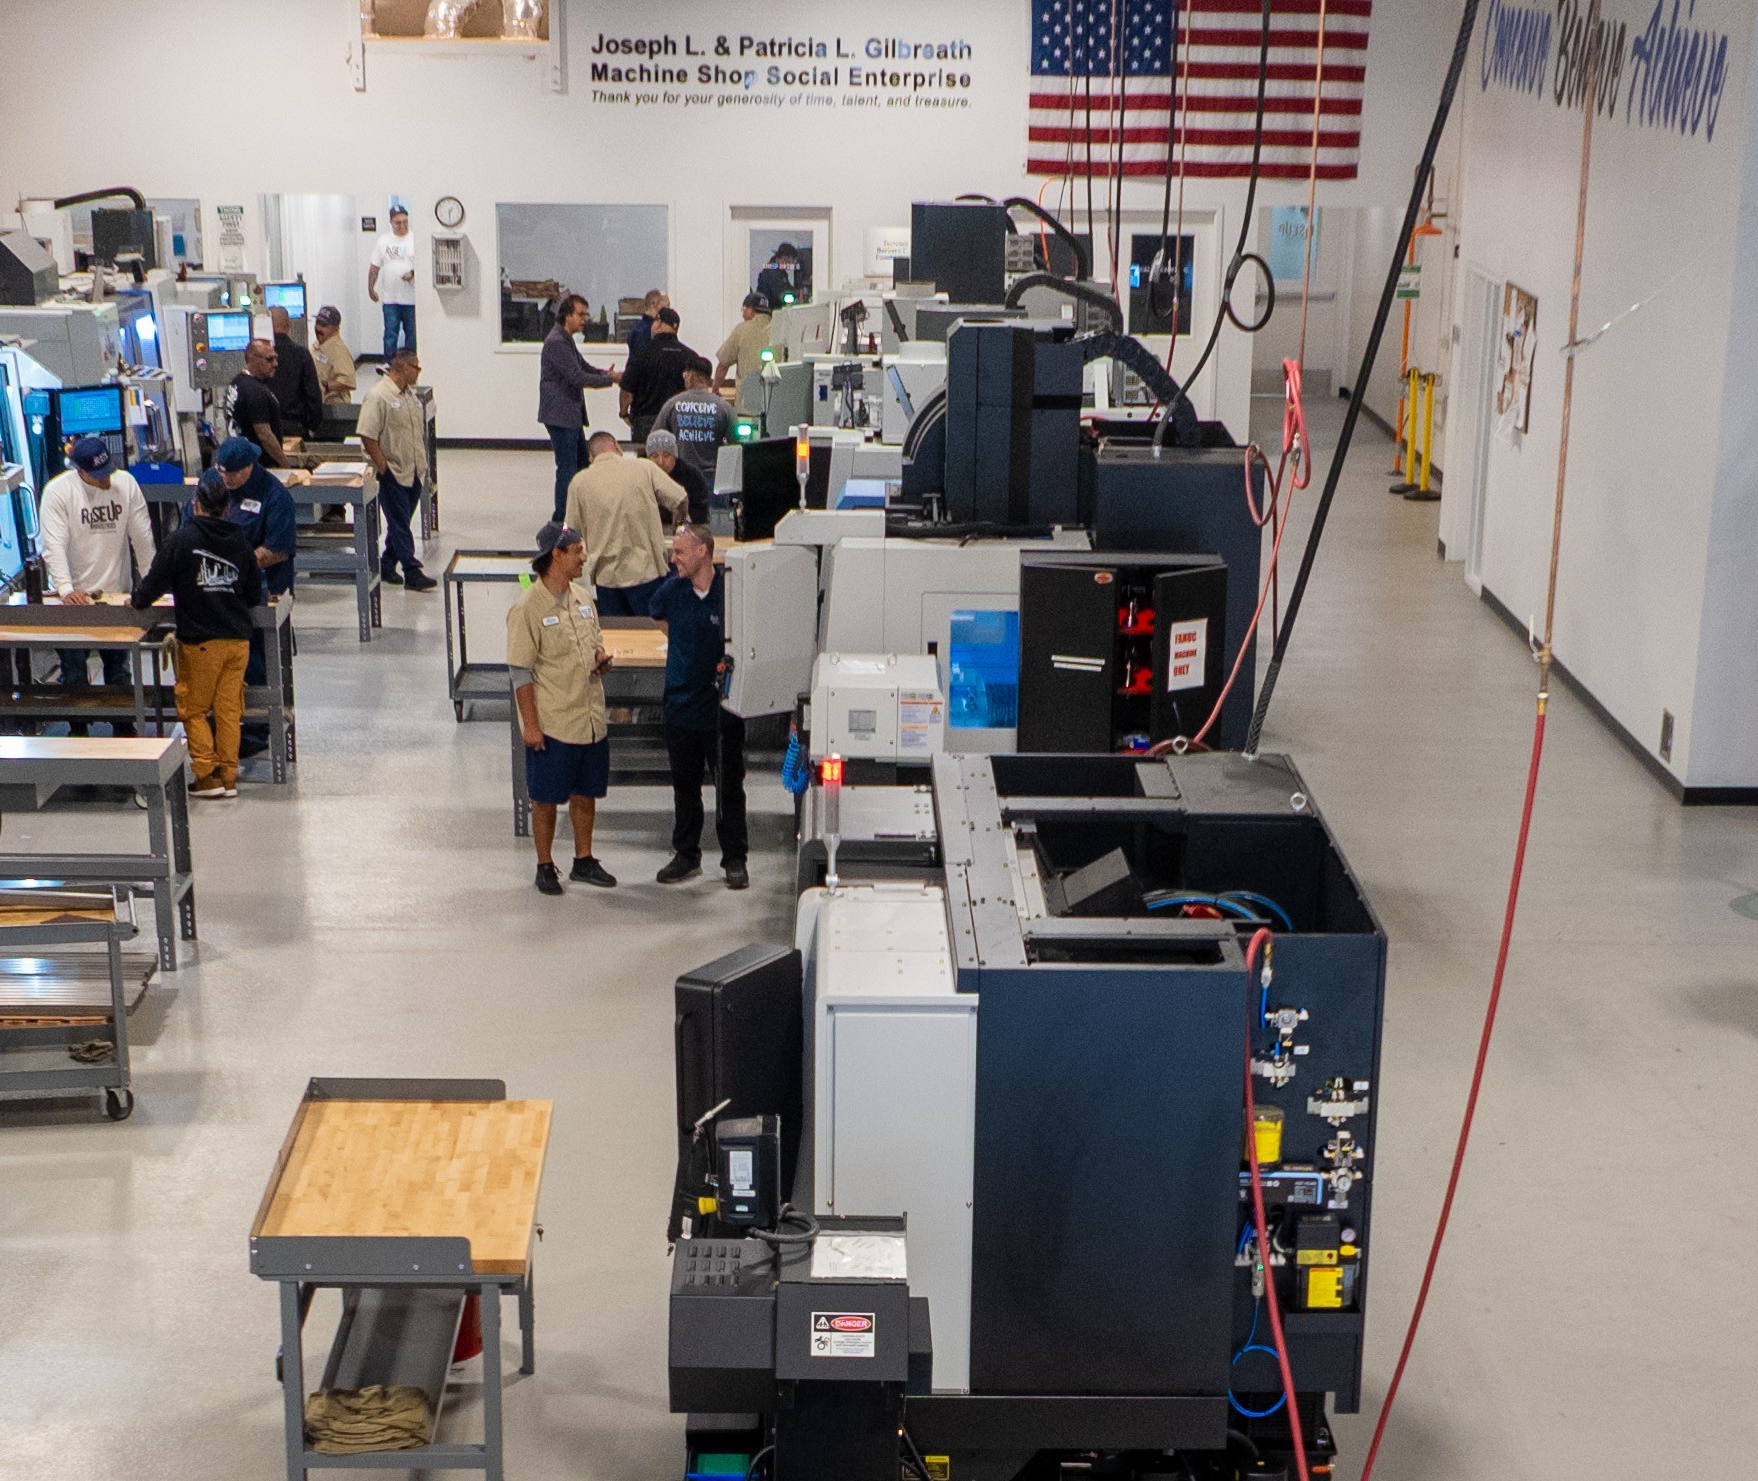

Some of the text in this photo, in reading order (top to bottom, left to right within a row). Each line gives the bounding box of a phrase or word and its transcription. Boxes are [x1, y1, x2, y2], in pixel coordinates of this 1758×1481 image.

[592, 33, 972, 60] Joseph L. & Patricia L. Gilbreath
[591, 62, 972, 91] Machine Shop Social Enterprise
[591, 90, 632, 104] Thank
[634, 93, 659, 107] you
[662, 91, 681, 104] for
[684, 92, 714, 107] your
[717, 91, 784, 108] generosity
[789, 92, 803, 106] of
[885, 94, 912, 107] and
[914, 95, 972, 109] treasure.
[835, 1319, 868, 1328] DANGER
